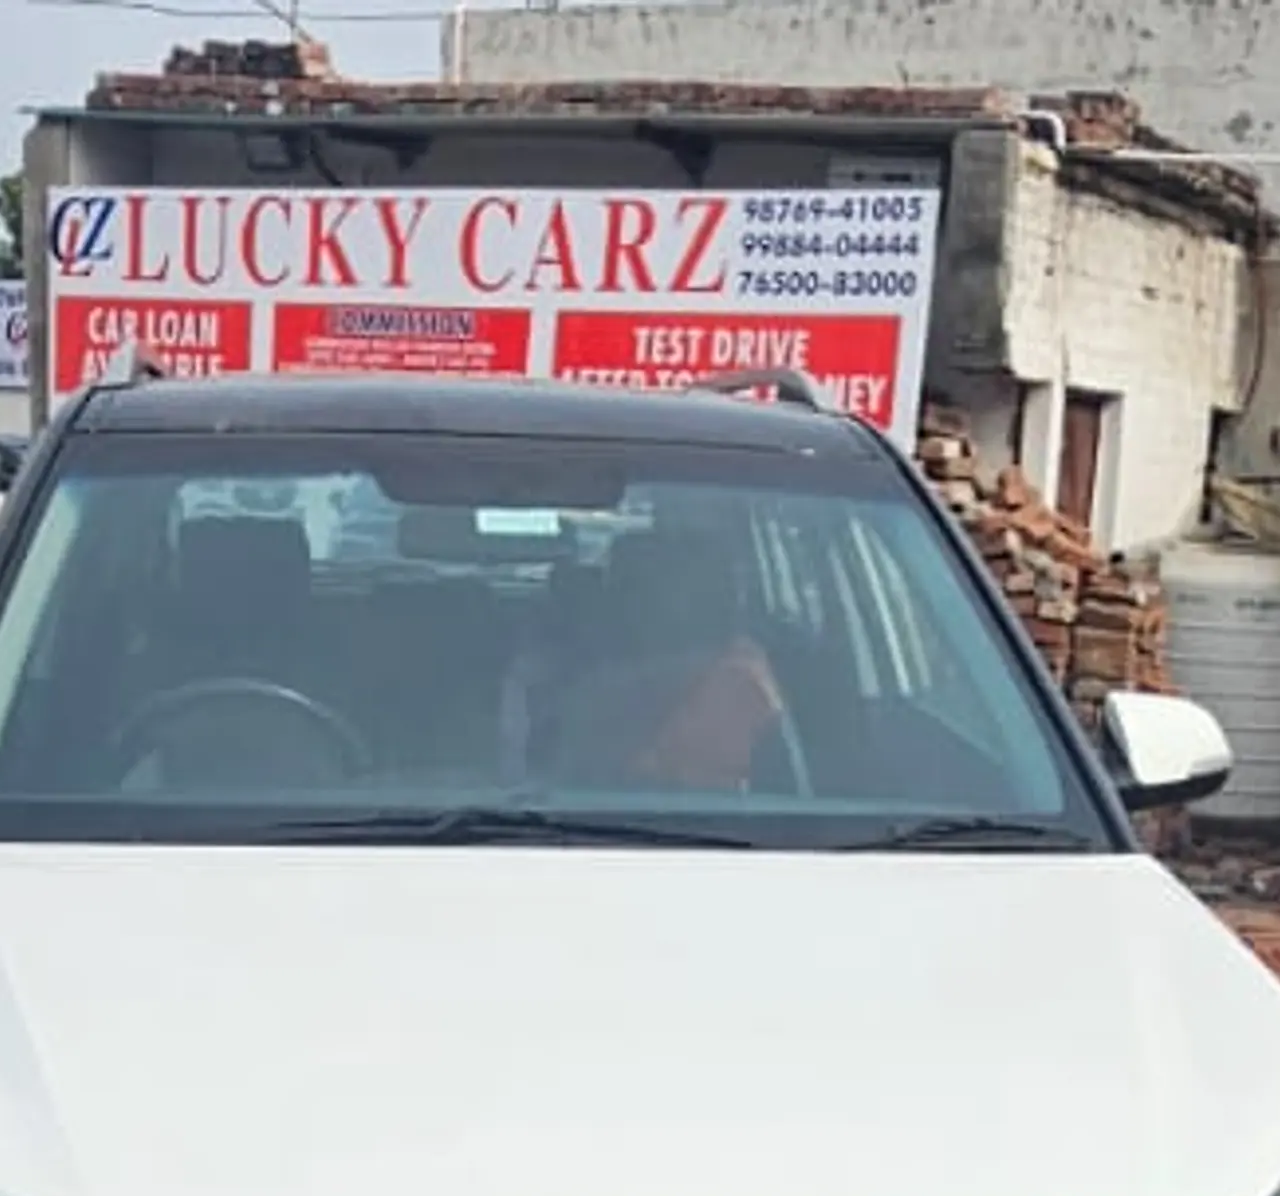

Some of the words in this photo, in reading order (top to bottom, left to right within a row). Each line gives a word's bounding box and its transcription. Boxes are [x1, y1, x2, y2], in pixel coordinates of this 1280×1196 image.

[744, 196, 923, 222] 98769-41005
[122, 194, 427, 288] LUCKY
[459, 196, 728, 293] CARZ
[737, 271, 917, 296] 76500-83000
[87, 306, 138, 345] CAR
[145, 308, 219, 348] LOAN
[631, 326, 703, 365] TEST
[711, 328, 812, 369] DRIVE
